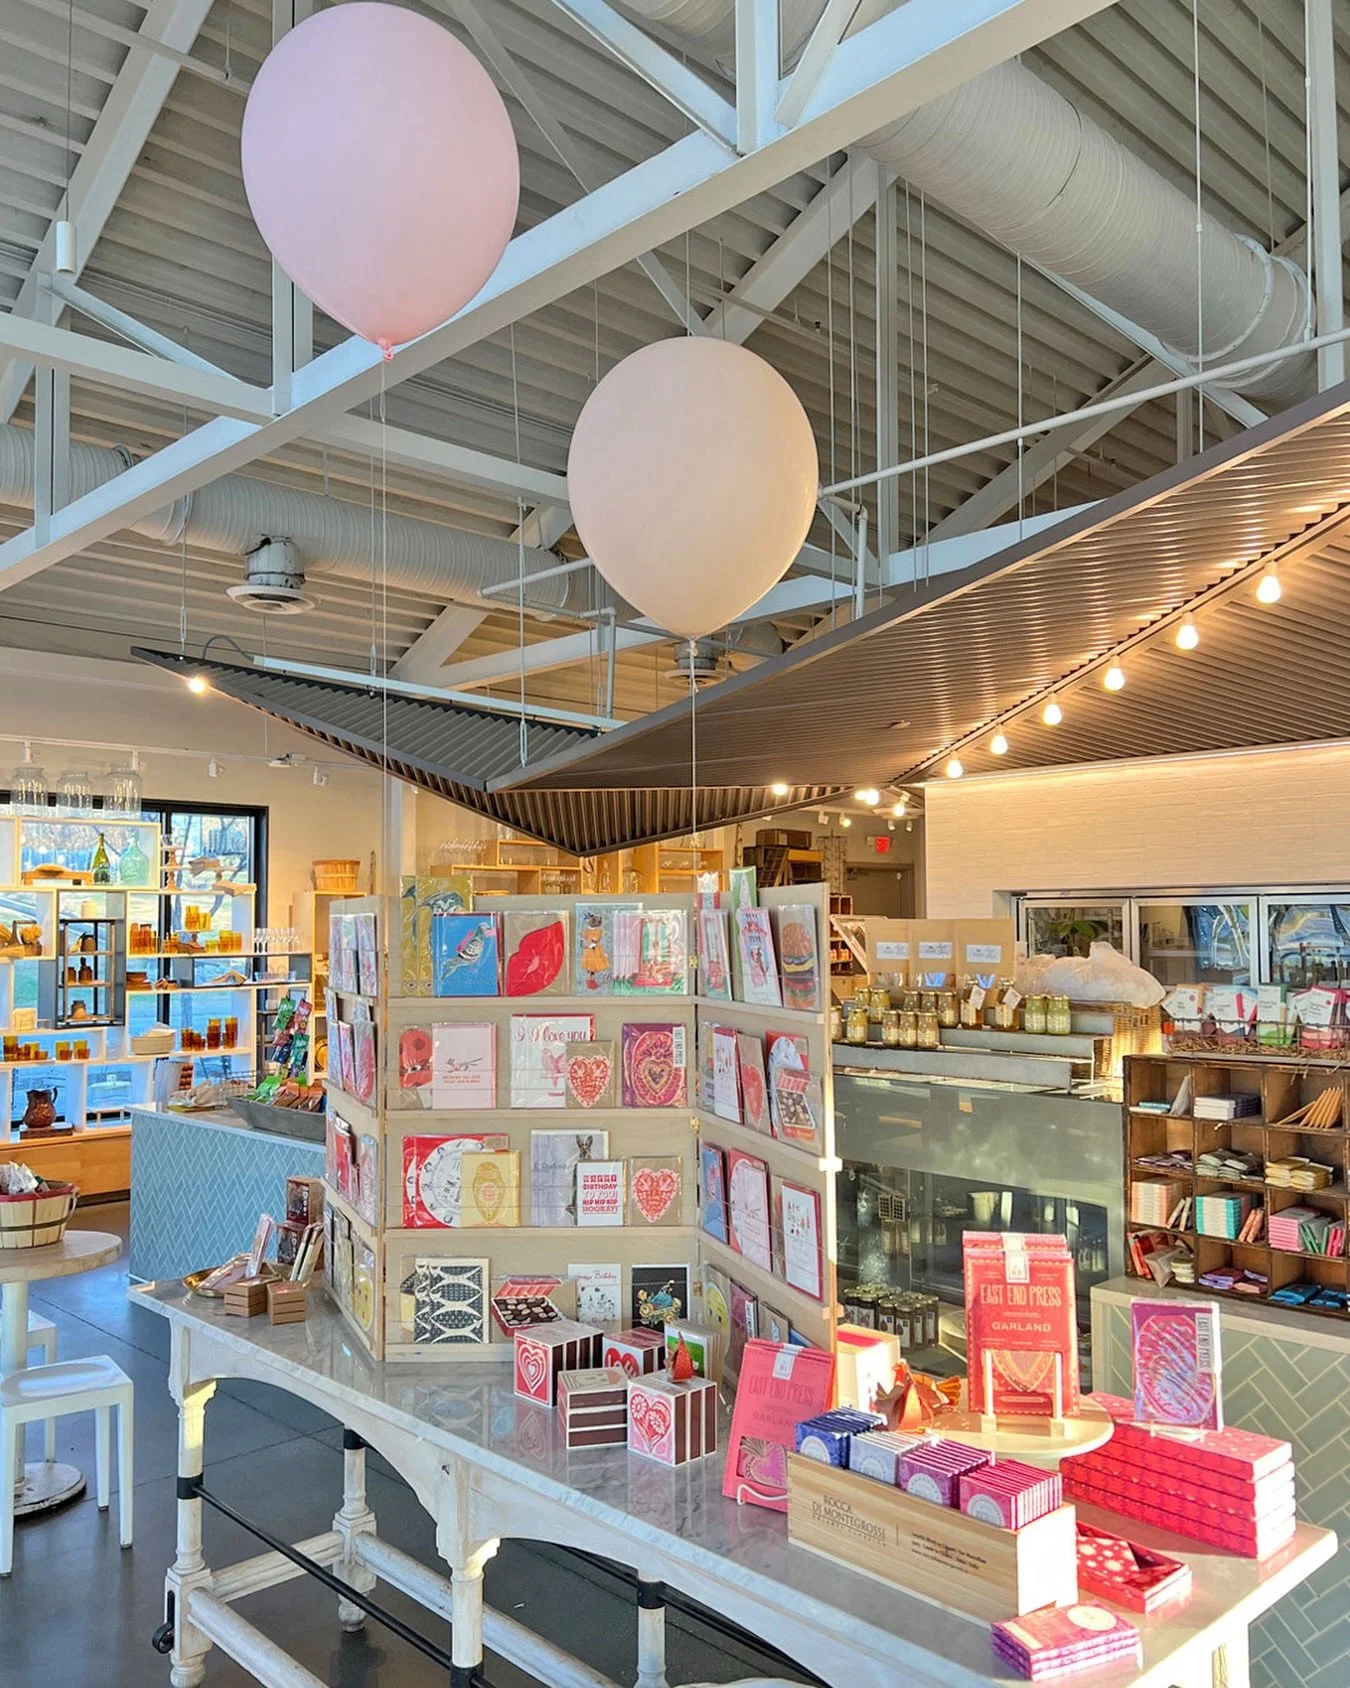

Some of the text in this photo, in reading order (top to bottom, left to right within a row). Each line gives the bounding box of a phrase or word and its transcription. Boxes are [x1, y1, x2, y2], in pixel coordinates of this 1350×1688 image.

[543, 1025, 566, 1042] love
[567, 1031, 587, 1043] you
[980, 1283, 1062, 1308] EAST END PRESS
[991, 1320, 1052, 1333] GARLAND
[748, 1375, 814, 1405] EAST END PRESS
[823, 1494, 853, 1514] ROCCA
[812, 1500, 886, 1540] DI MONTEGROSSI
